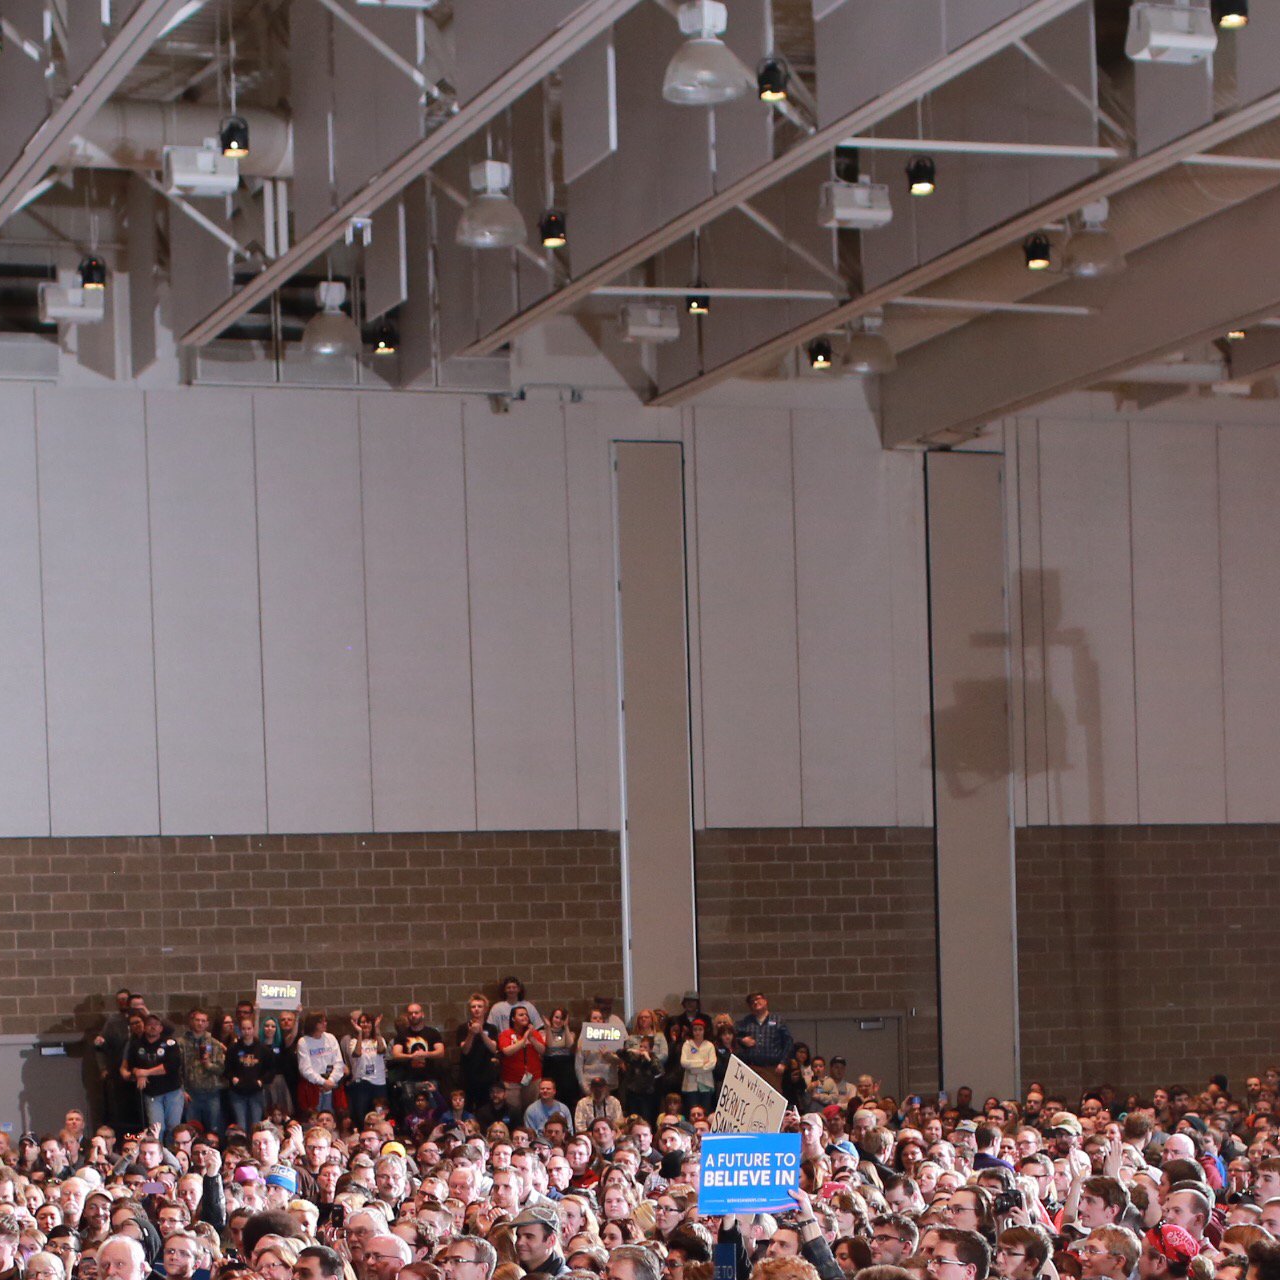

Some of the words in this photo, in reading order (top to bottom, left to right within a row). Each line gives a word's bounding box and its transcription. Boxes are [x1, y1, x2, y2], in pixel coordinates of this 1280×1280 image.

[261, 984, 297, 998] Bernie
[586, 1026, 621, 1040] Bernie
[747, 1080, 765, 1102] voting
[719, 1084, 751, 1126] BERNIE
[705, 1153, 715, 1167] A
[718, 1153, 771, 1167] FUTURE
[775, 1152, 796, 1167] TO
[704, 1169, 771, 1187] BELIEVE
[775, 1169, 795, 1186] IN
[722, 1265, 733, 1279] TO
